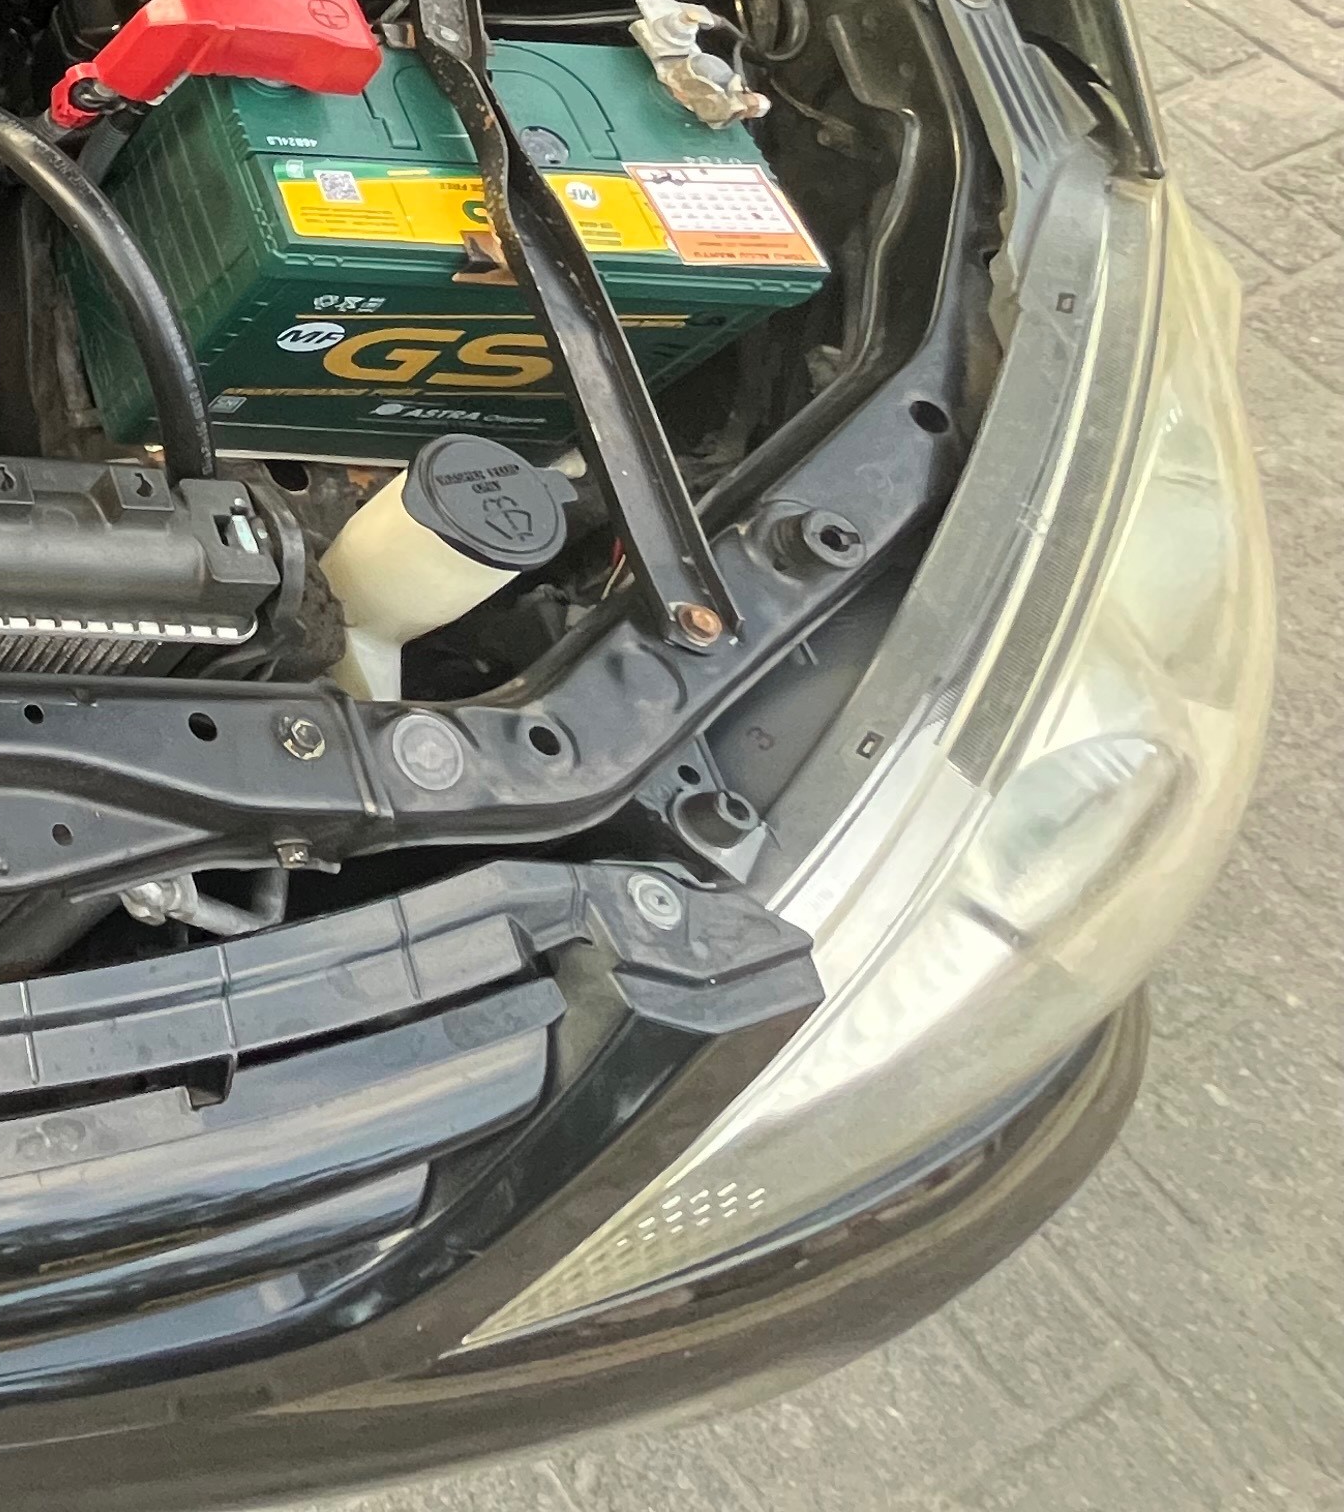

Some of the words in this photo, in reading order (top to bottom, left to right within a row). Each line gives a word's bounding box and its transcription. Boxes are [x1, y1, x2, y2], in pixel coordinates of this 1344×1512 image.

[567, 188, 597, 202] MF
[278, 329, 346, 344] MF
[323, 326, 555, 388] GS
[400, 408, 481, 420] ASTRA
